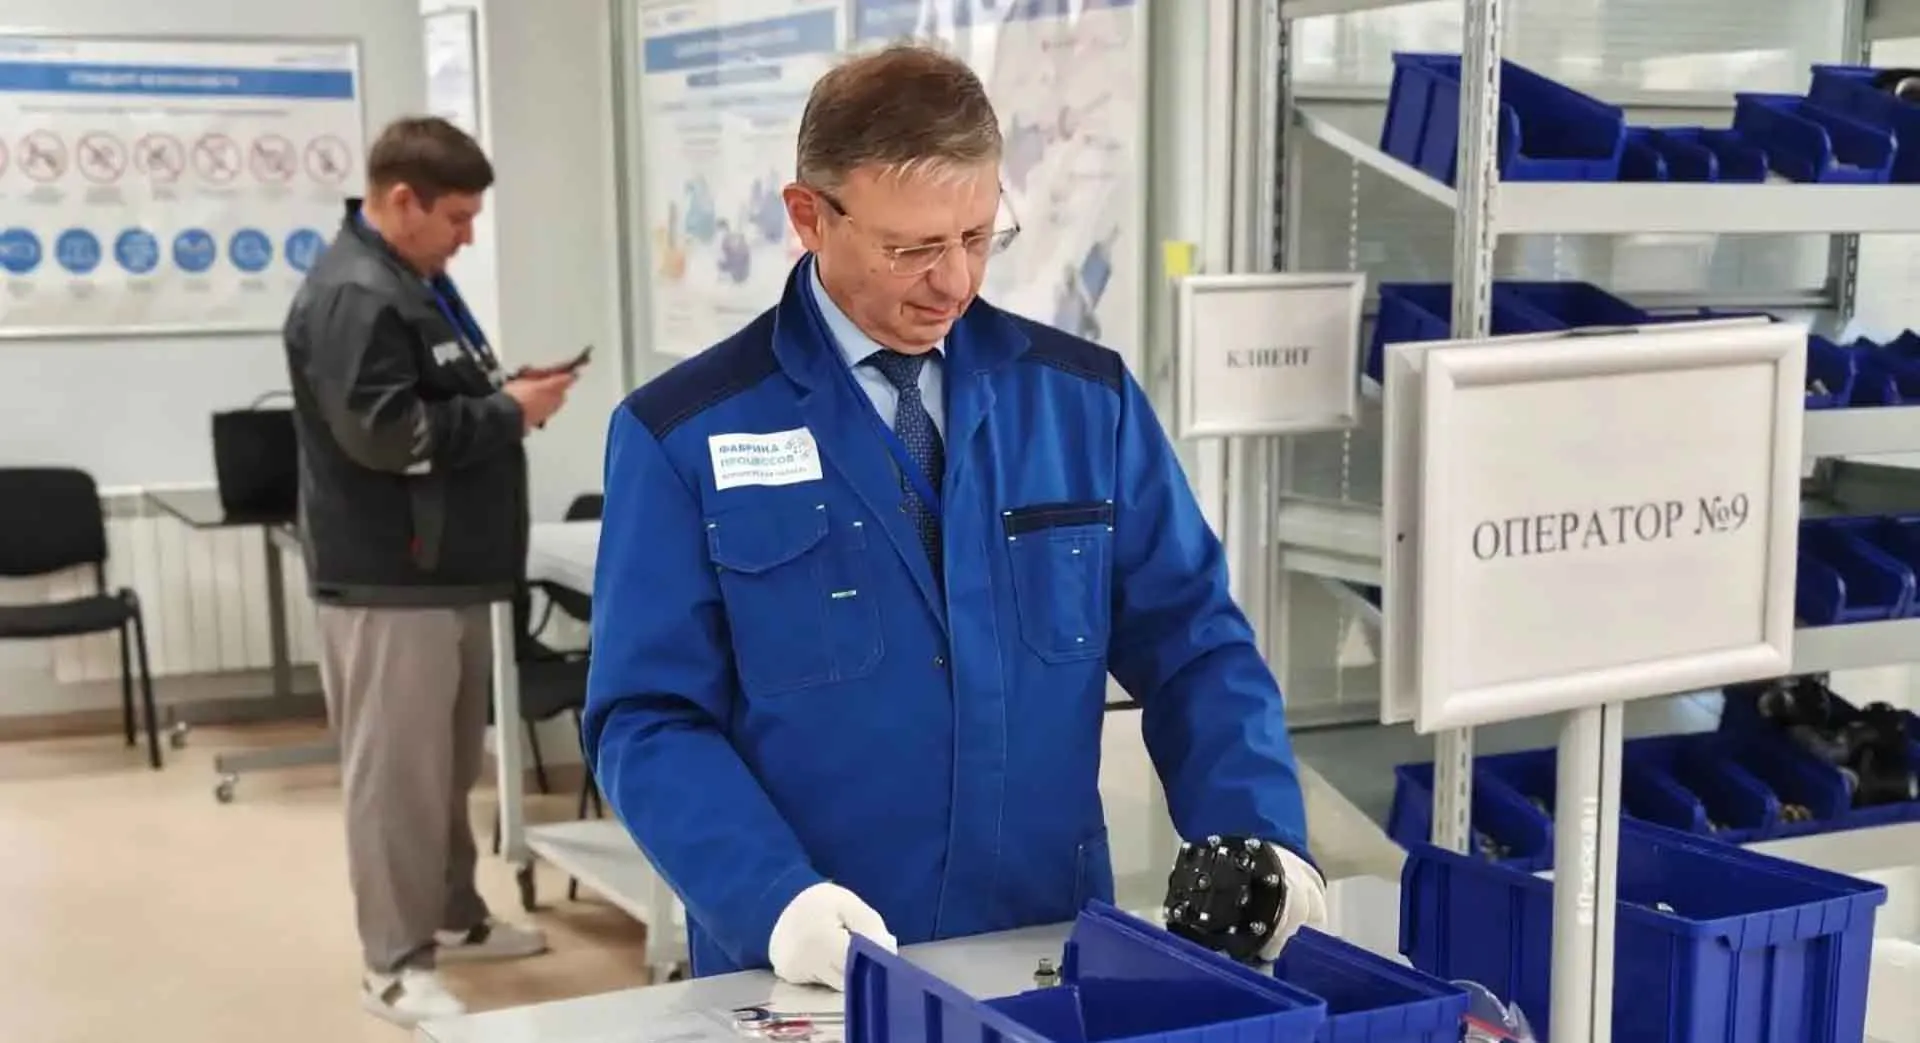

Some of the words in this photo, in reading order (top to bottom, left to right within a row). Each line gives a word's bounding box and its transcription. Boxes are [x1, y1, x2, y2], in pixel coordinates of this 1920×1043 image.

[1226, 346, 1313, 368] КЛИЕНТ
[719, 443, 779, 454] ФАБРИКА
[1472, 500, 1684, 561] ОПЕРАТОР
[1693, 493, 1749, 536] №9
